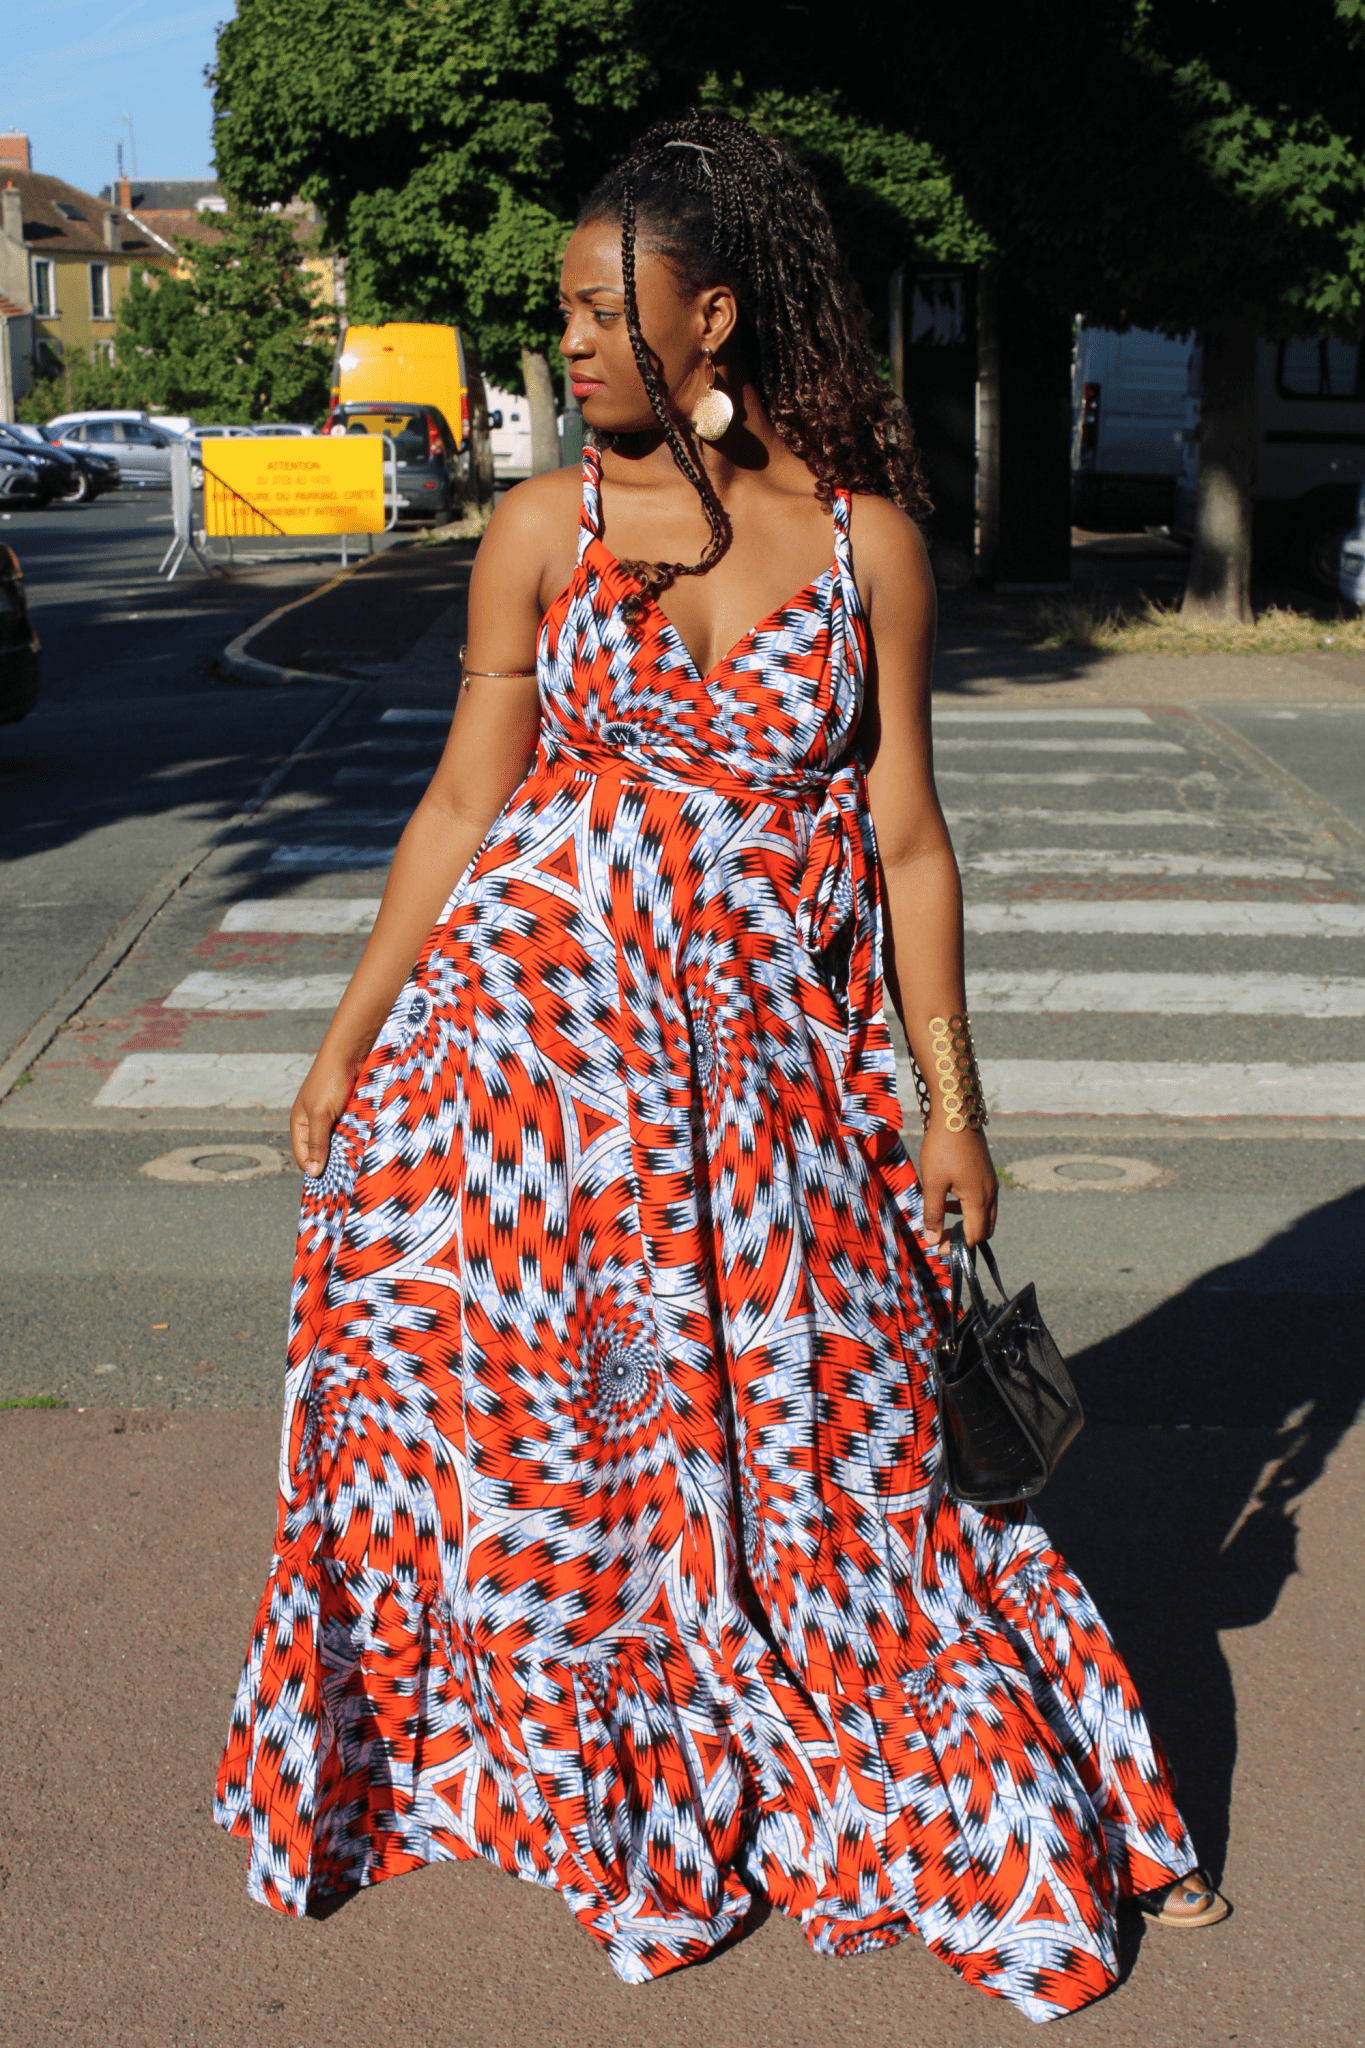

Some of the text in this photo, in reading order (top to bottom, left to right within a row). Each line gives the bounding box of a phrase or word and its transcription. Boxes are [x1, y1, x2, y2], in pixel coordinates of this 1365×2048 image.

[266, 461, 321, 471] ATTENTION
[275, 491, 291, 502] DU
[294, 491, 338, 501] PARKING
[612, 731, 630, 743] W
